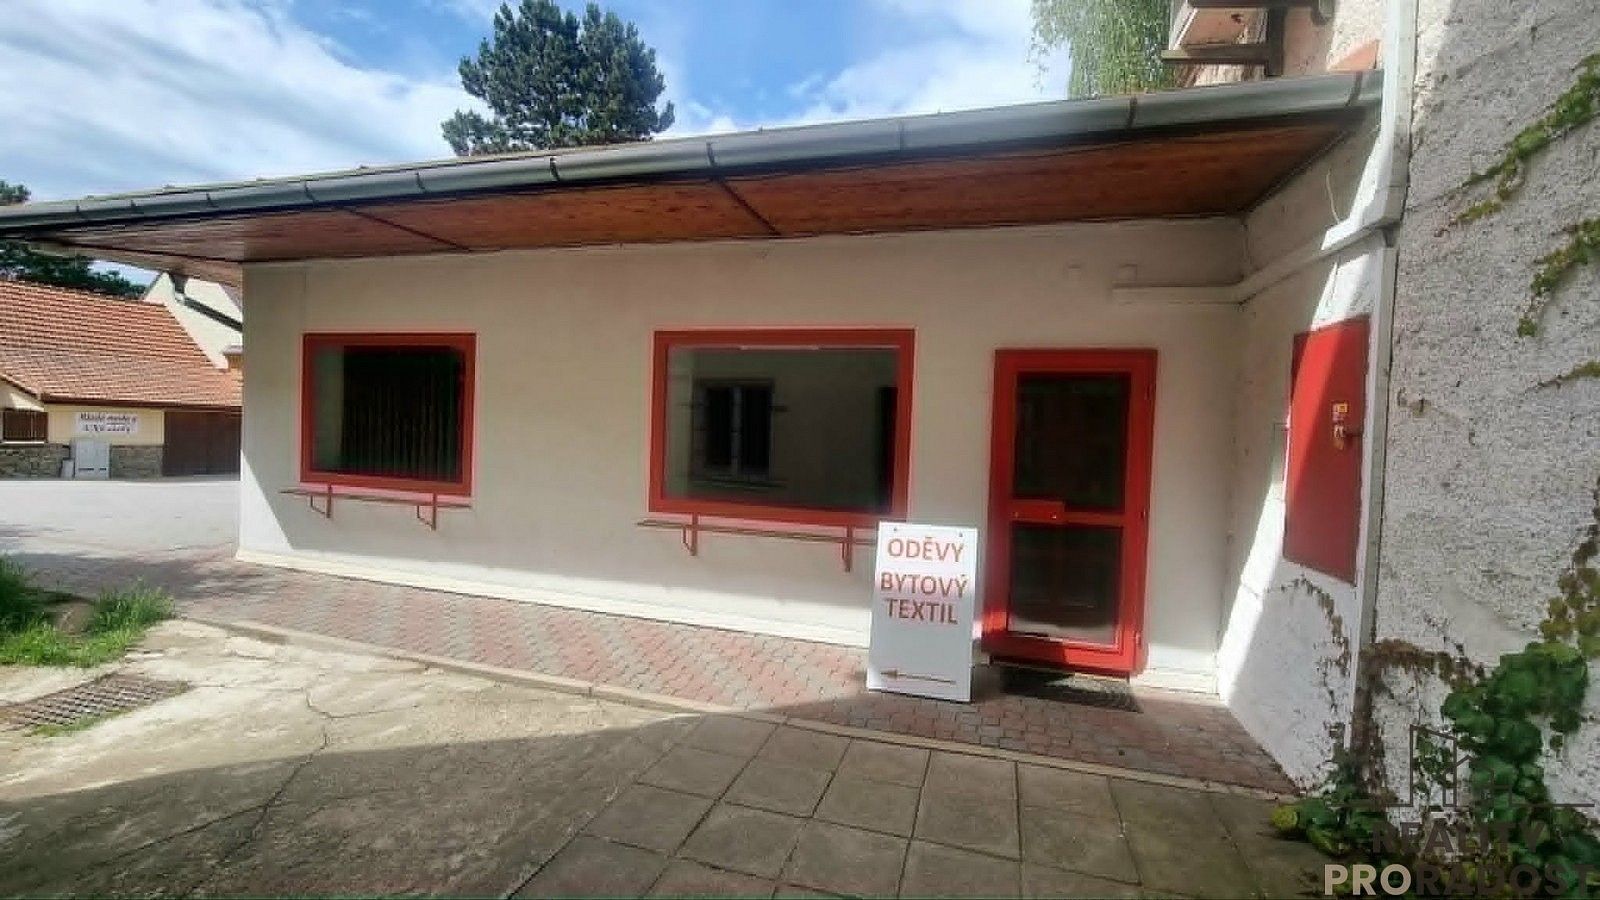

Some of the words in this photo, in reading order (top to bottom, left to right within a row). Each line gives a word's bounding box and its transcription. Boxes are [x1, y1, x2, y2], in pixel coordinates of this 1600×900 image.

[887, 536, 965, 562] ODĚVY
[880, 572, 969, 598] BYTOVÝ
[885, 599, 959, 625] TEXTIL
